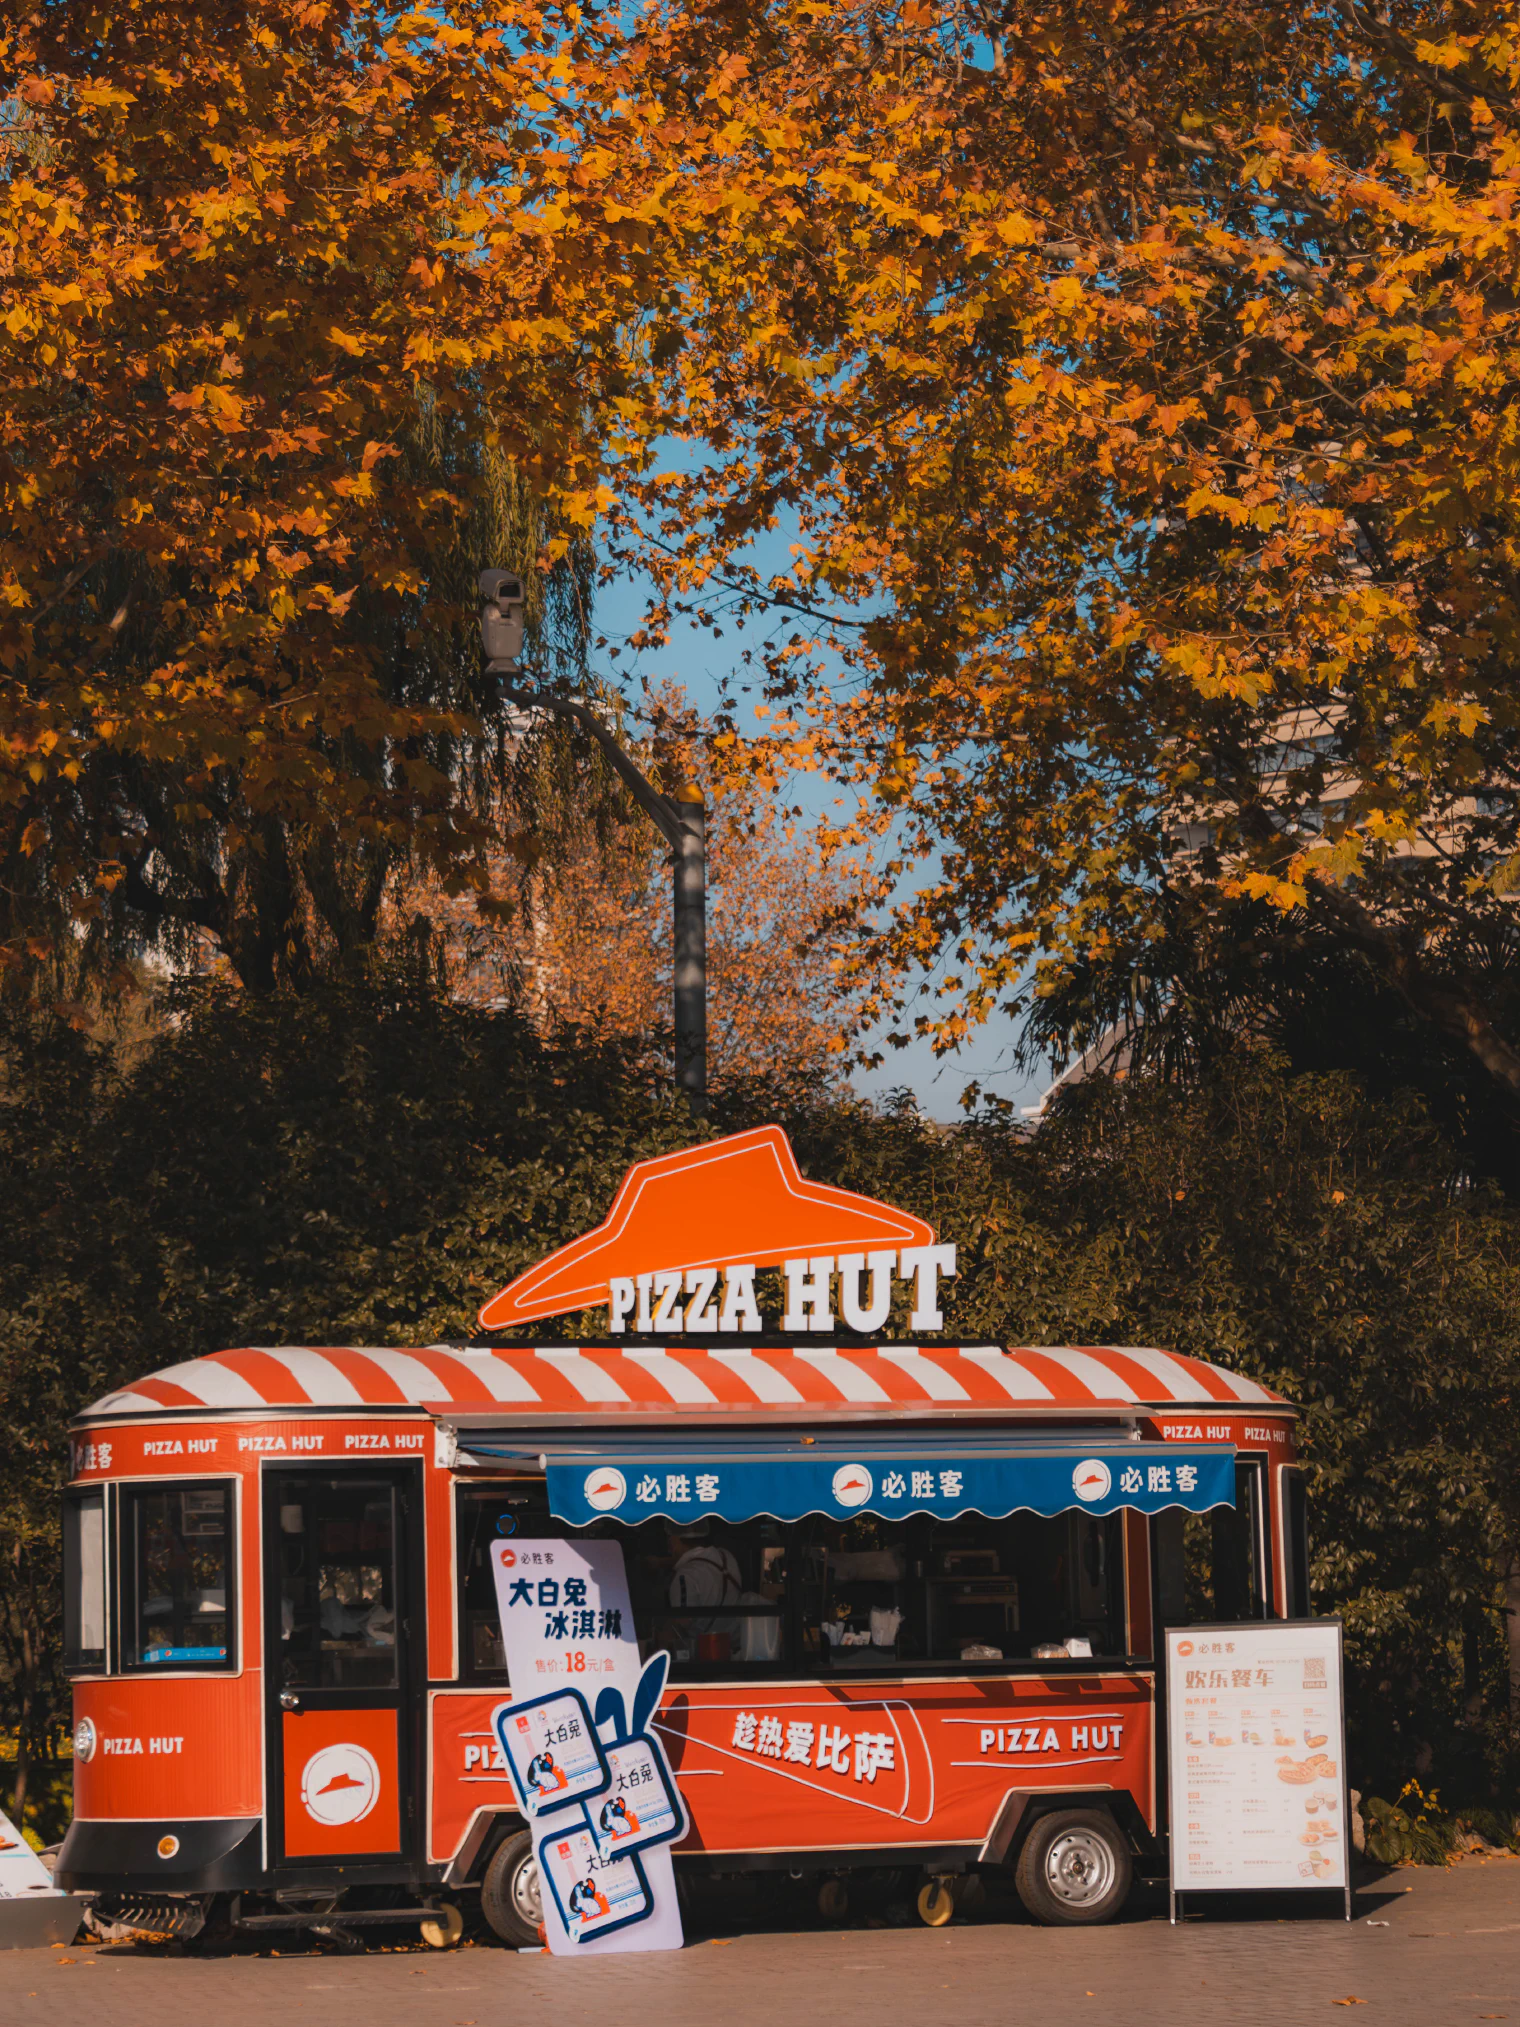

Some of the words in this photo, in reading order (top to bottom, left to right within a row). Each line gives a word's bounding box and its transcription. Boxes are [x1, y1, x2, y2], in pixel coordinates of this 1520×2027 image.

[609, 1263, 762, 1333] PIZZA
[779, 1243, 956, 1334] HUT
[238, 1437, 287, 1451] PIZZA
[292, 1435, 324, 1450] HUT
[345, 1435, 390, 1448] PIZZA
[395, 1434, 425, 1448] HUT
[1163, 1425, 1203, 1439] PIZZA
[1206, 1426, 1231, 1439] HUT
[1244, 1427, 1271, 1441] PIZZA
[1273, 1430, 1286, 1443] HUT
[143, 1440, 184, 1456] PIZZA
[187, 1438, 219, 1453] HUT
[635, 1473, 721, 1503] 必胜客
[881, 1469, 965, 1499] 必胜客
[1119, 1465, 1199, 1494] 必胜客
[520, 1552, 555, 1565] 必胜客
[508, 1576, 588, 1608] 大白兔
[544, 1608, 622, 1640] 冰淇淋
[1197, 1641, 1236, 1655] 必胜客
[1184, 1668, 1275, 1690] 欢乐餐车
[103, 1738, 144, 1755] PIZZA
[149, 1737, 184, 1754] HUT
[544, 1718, 582, 1748] 大白兔
[979, 1728, 1060, 1753] PIZZA
[1071, 1725, 1124, 1750] HUT
[464, 1744, 505, 1770] PIZ
[731, 1711, 895, 1784] 趁热爱比萨
[616, 1762, 654, 1792] 大白兔
